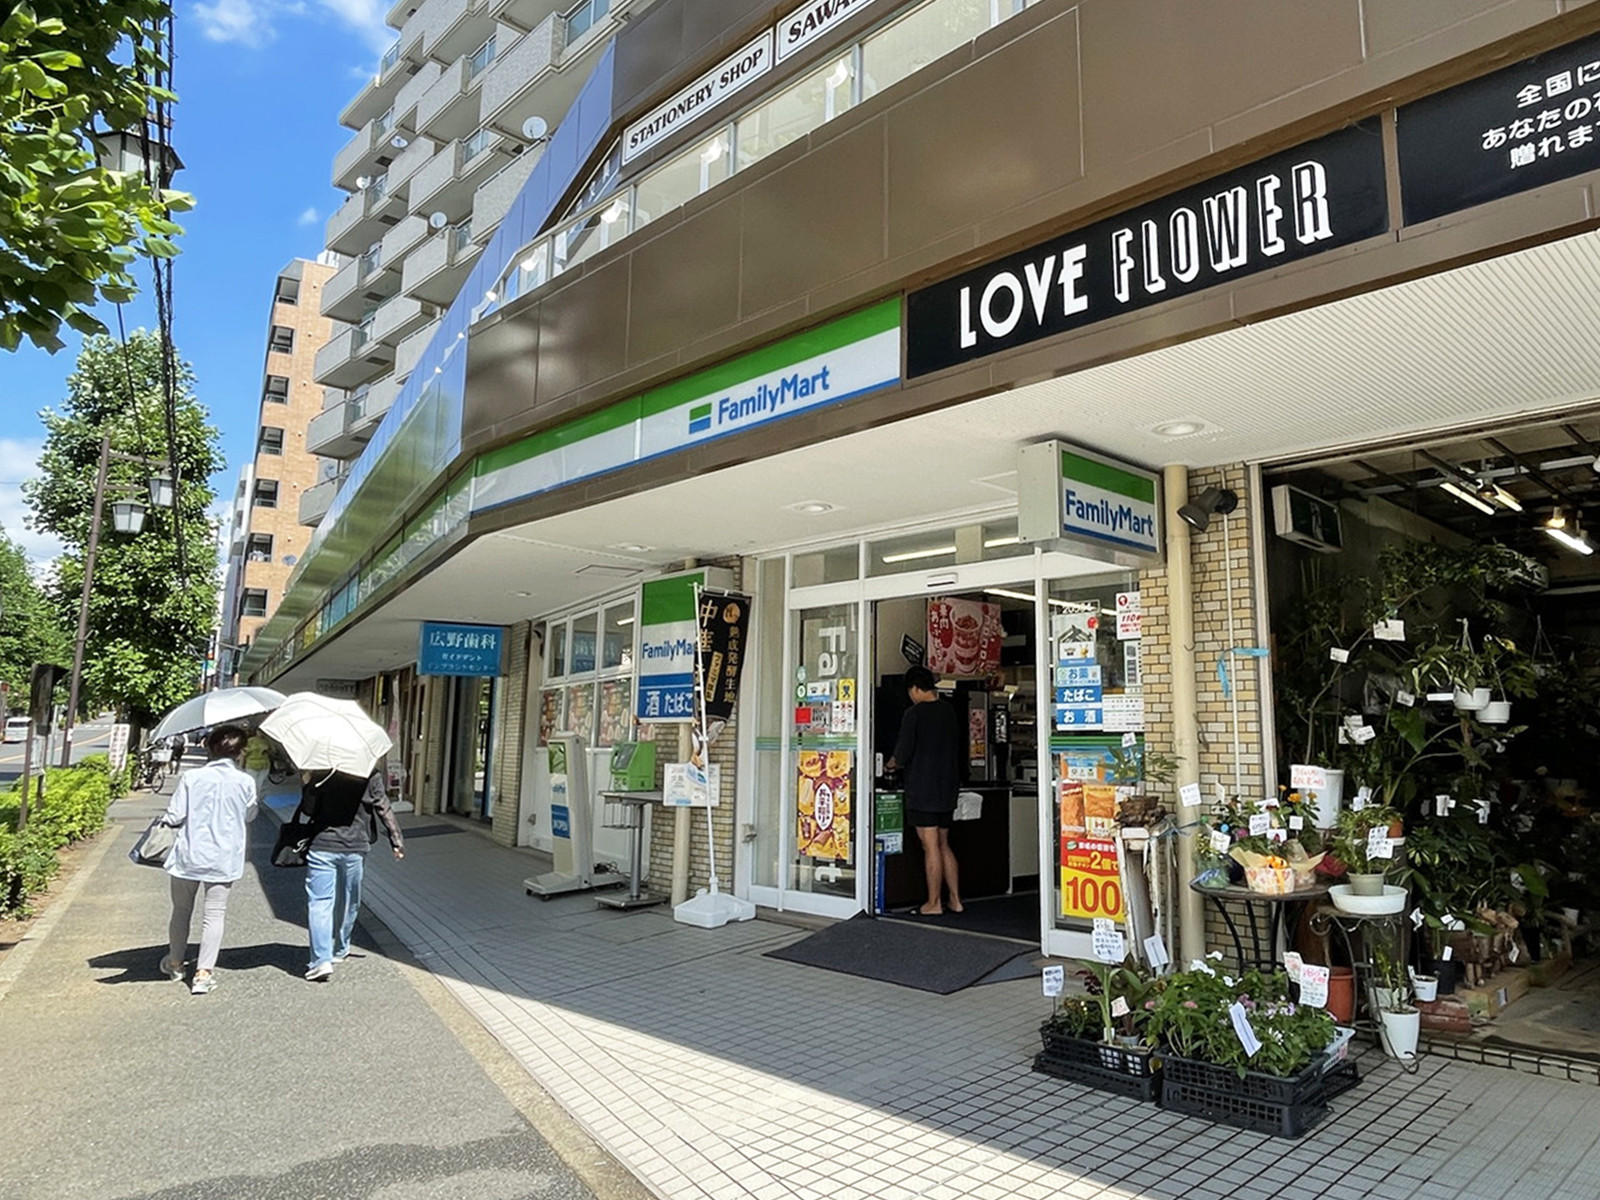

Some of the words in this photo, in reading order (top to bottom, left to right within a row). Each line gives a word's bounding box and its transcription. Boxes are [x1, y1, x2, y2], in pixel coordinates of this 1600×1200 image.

[787, 0, 856, 43] SAWA
[629, 80, 716, 149] STATIONERY
[719, 48, 763, 89] SHOP
[1481, 91, 1600, 150] あなたの
[1509, 121, 1600, 169] 贈れま
[960, 243, 1088, 349] LOVE
[1111, 160, 1334, 303] FLOWER
[718, 365, 830, 425] FamilyMart
[1065, 488, 1154, 538] FamilyMart
[430, 631, 497, 650] 広野歯科
[642, 639, 697, 661] FamilyMa
[645, 690, 661, 716] 酒
[664, 692, 693, 714] たばこ
[1063, 689, 1096, 702] たばこ
[1063, 710, 1097, 723] お酒
[1066, 876, 1121, 917] 100
